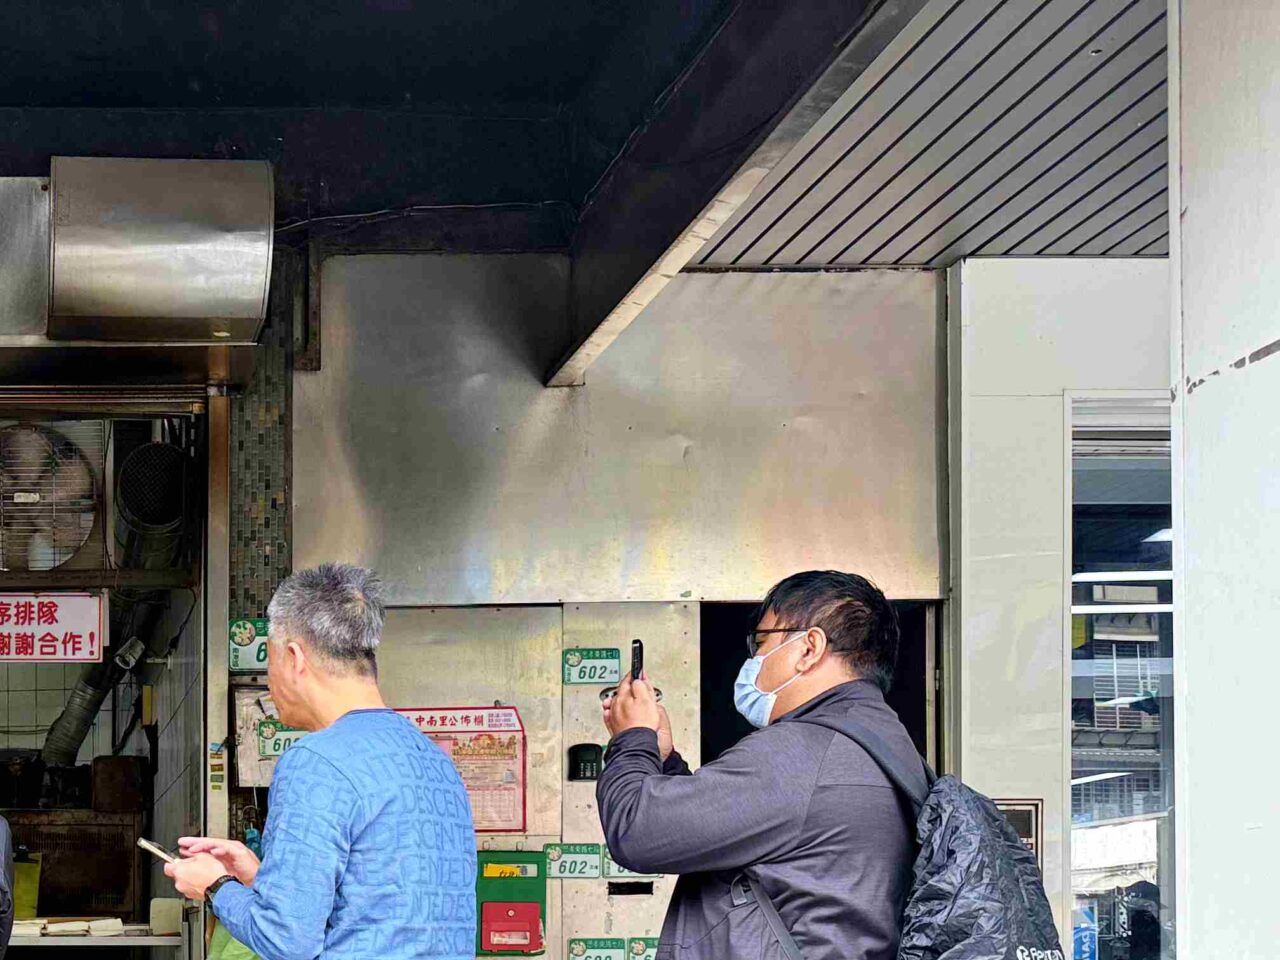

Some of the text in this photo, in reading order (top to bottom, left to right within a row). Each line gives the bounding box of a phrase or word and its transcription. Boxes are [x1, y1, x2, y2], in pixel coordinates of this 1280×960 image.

[256, 642, 268, 663] 6
[578, 665, 607, 679] 602
[273, 737, 300, 752] 60
[559, 860, 588, 874] 602
